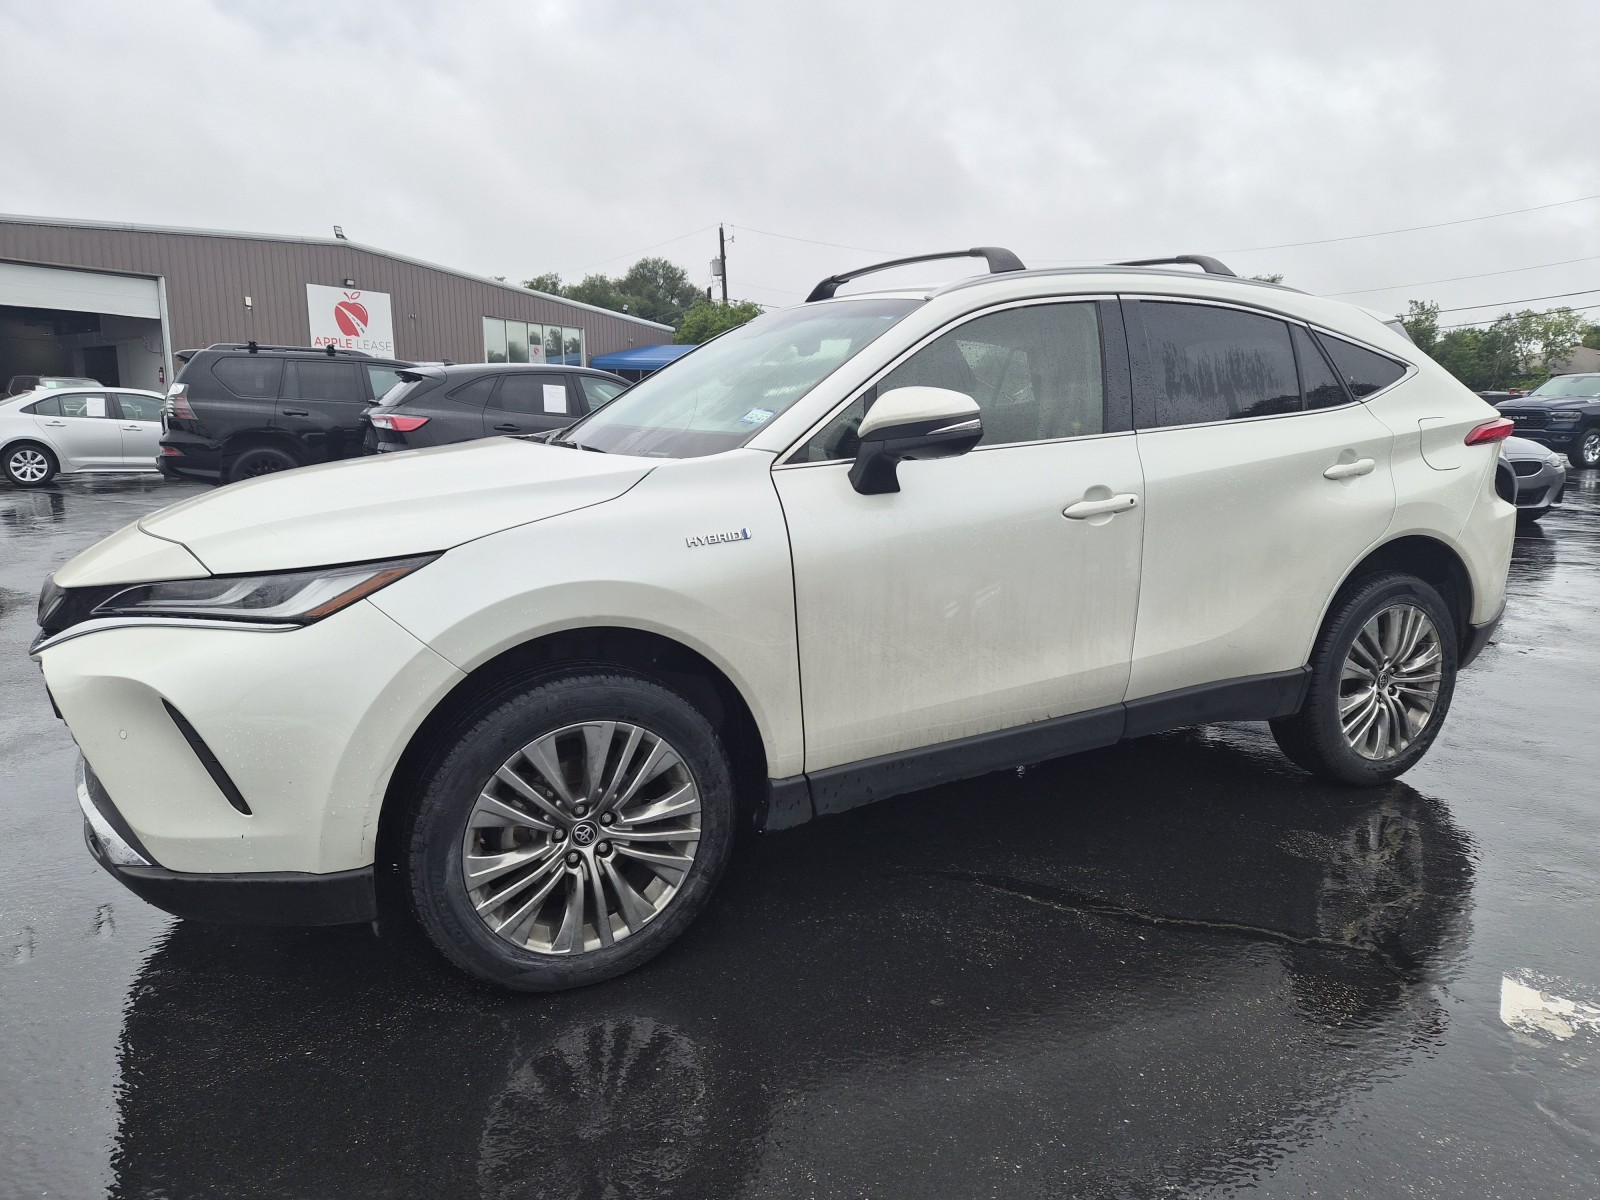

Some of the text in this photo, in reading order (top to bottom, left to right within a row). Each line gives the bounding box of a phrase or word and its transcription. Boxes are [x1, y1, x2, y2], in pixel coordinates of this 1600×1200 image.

[314, 336, 393, 352] APPLE LEASE
[686, 532, 741, 547] HYBRID
